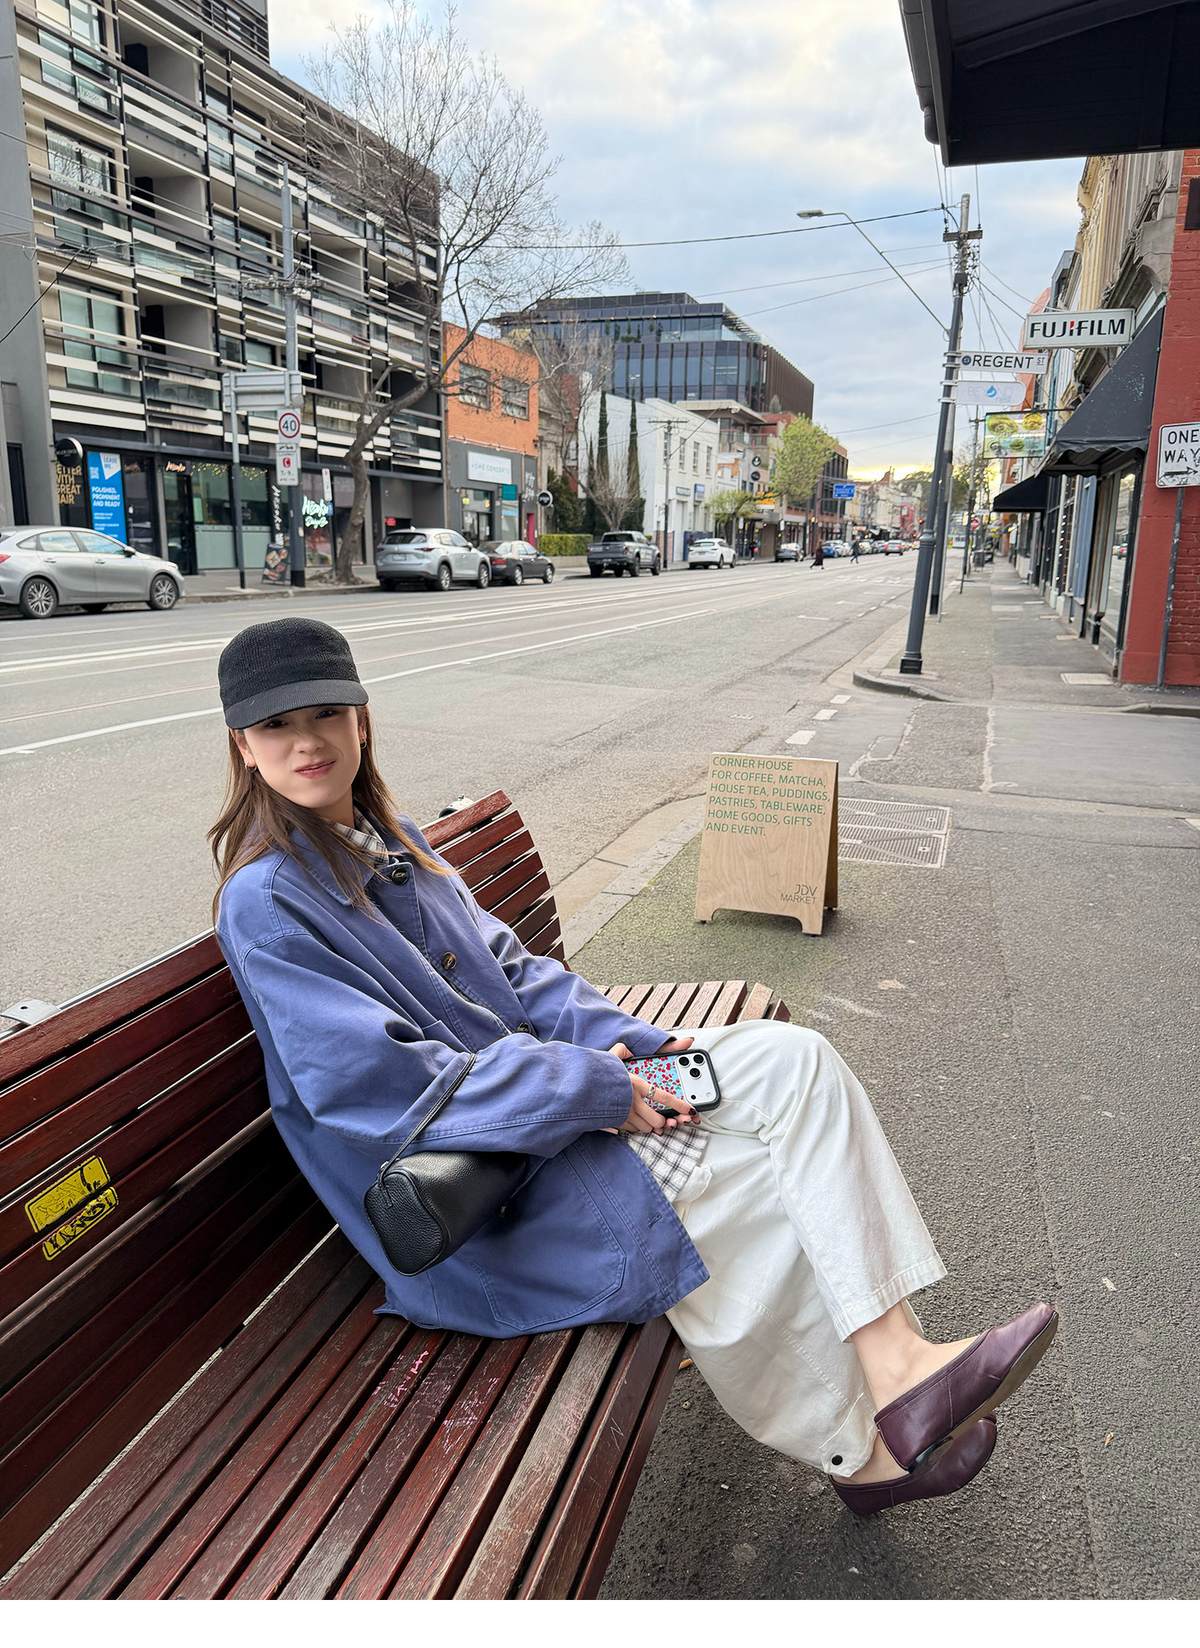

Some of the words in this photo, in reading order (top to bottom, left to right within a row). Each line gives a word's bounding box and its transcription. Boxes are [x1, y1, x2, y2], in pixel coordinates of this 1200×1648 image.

[1029, 318, 1126, 338] FUJIFILM
[971, 354, 1034, 369] REGENT
[1036, 357, 1045, 366] ST
[282, 419, 297, 432] 40
[1167, 429, 1200, 445] ONE
[1164, 448, 1200, 464] WAY
[712, 756, 756, 768] CORNER
[757, 759, 793, 771] HOUSE
[711, 769, 732, 780] FOR
[734, 771, 776, 785] COFFEE,
[778, 775, 827, 788] MATCHA,
[710, 783, 744, 795] HOUSE
[747, 785, 769, 797] TEA,
[772, 787, 831, 803] PUDDINGS,
[708, 796, 758, 810] PASTRIES,
[760, 800, 826, 816] TABLEWARE,
[707, 809, 739, 820] HOME
[741, 811, 780, 826] GOODS,
[783, 815, 813, 827] GIFTS
[705, 822, 729, 833] AND
[731, 824, 767, 837] EVENT.
[794, 884, 818, 896] JDV
[780, 893, 818, 905] MARKET
